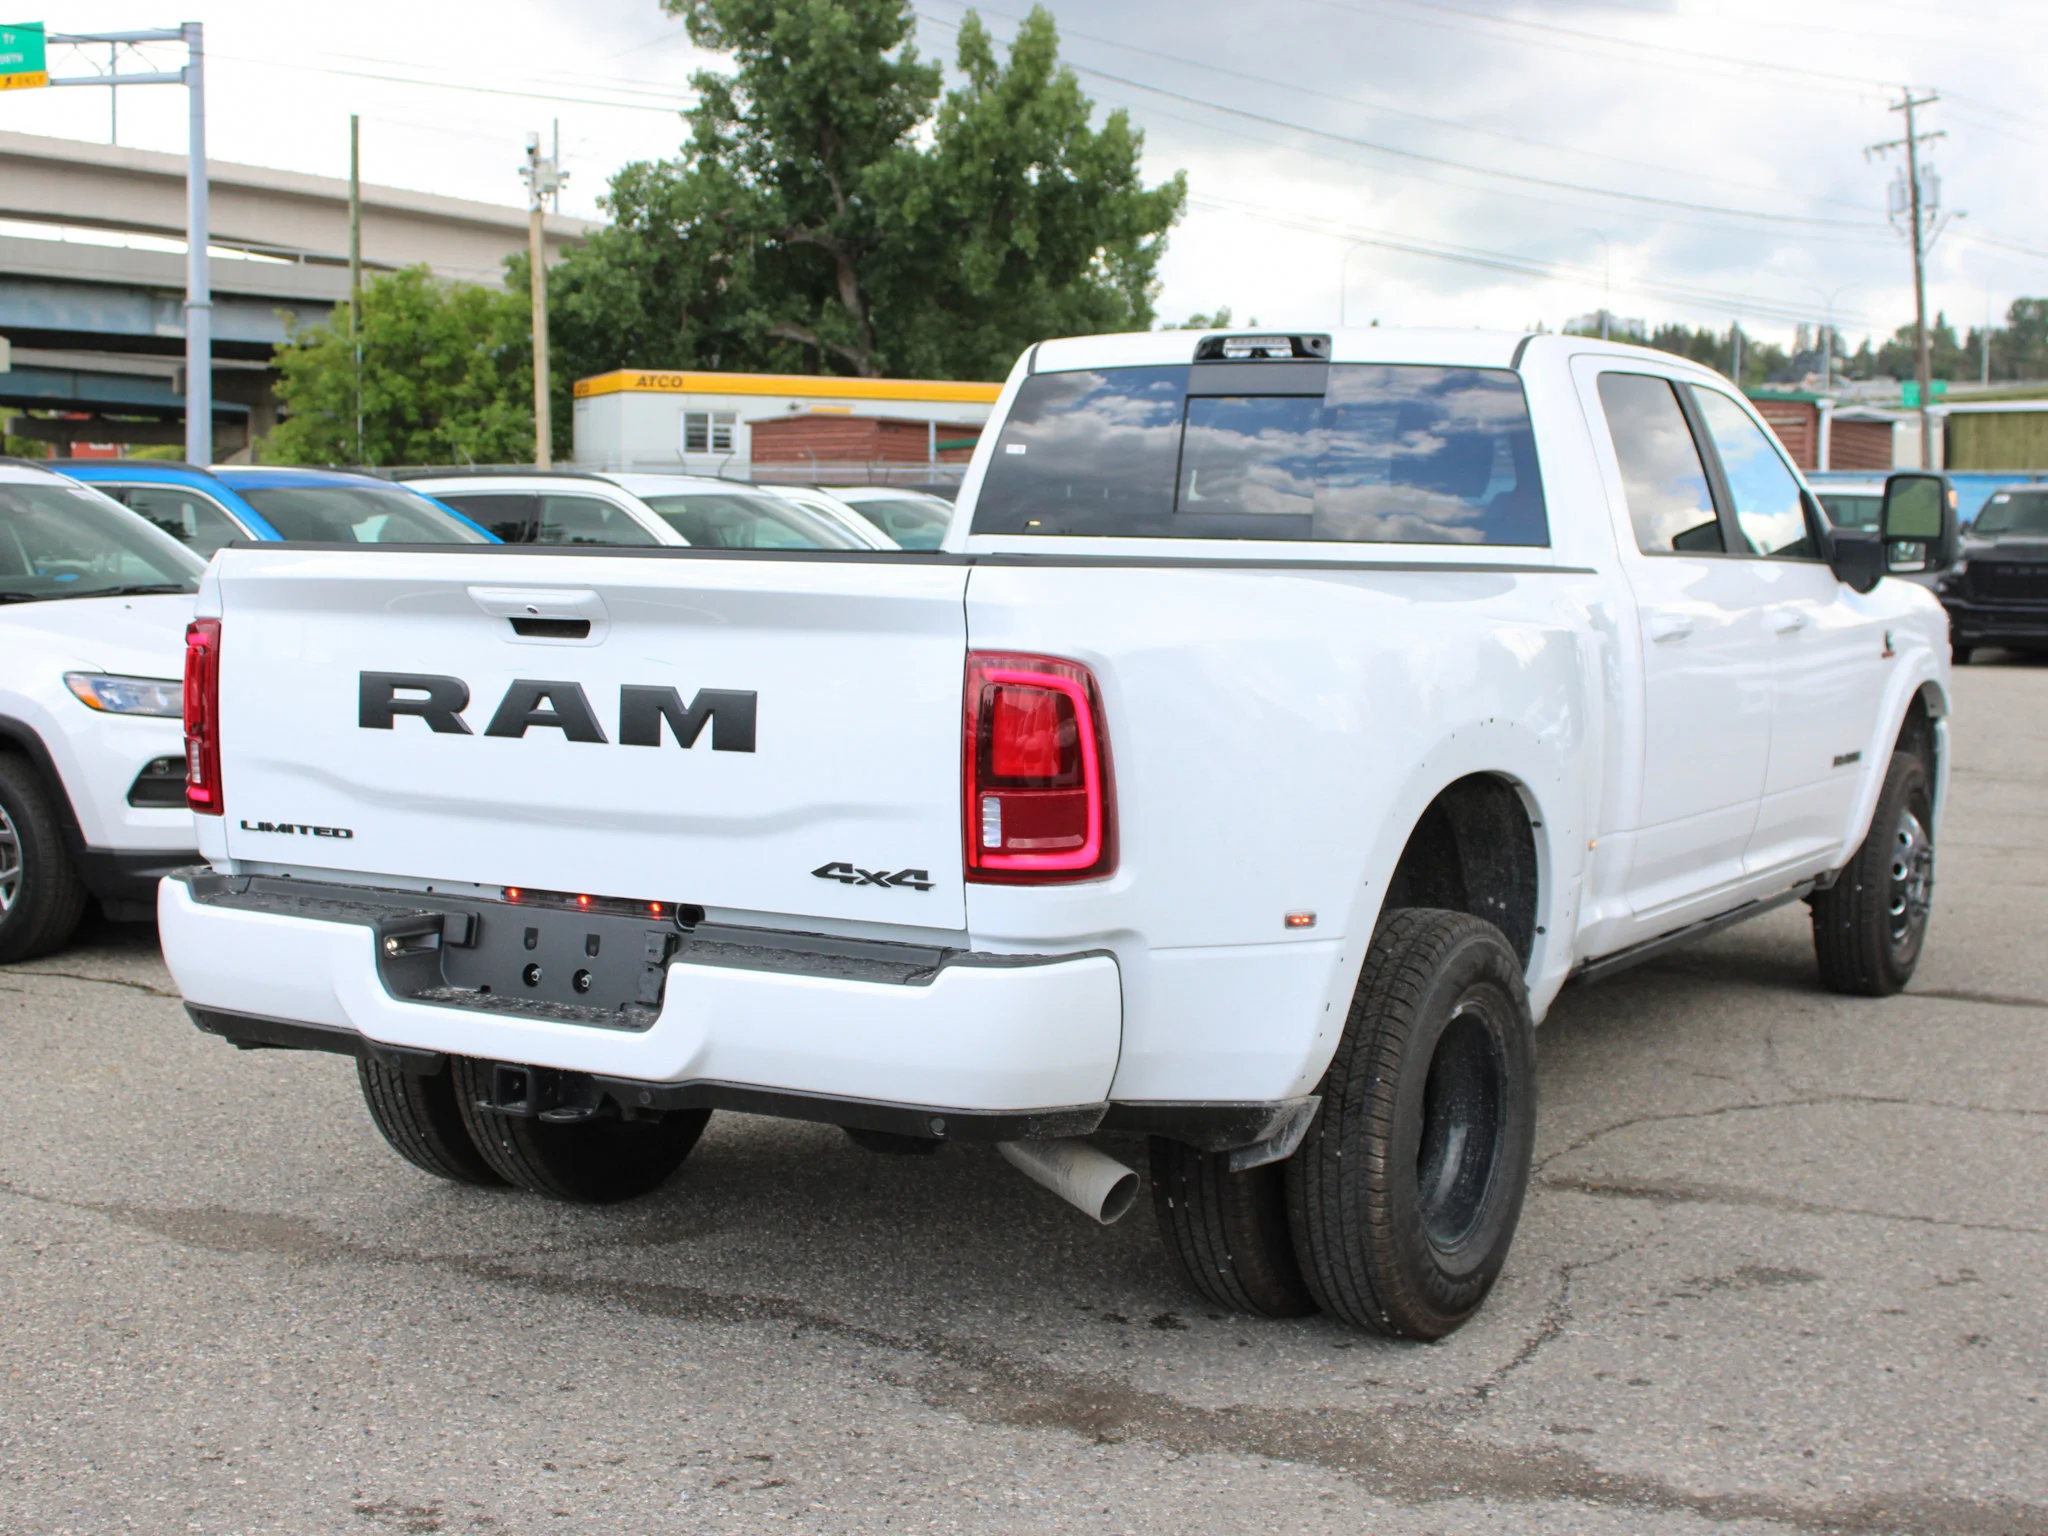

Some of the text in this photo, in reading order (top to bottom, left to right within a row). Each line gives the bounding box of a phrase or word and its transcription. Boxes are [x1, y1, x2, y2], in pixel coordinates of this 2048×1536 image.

[635, 375, 684, 388] ATCO
[358, 670, 758, 753] RAM
[240, 819, 354, 839] LIMITED
[810, 861, 937, 892] 4x4
